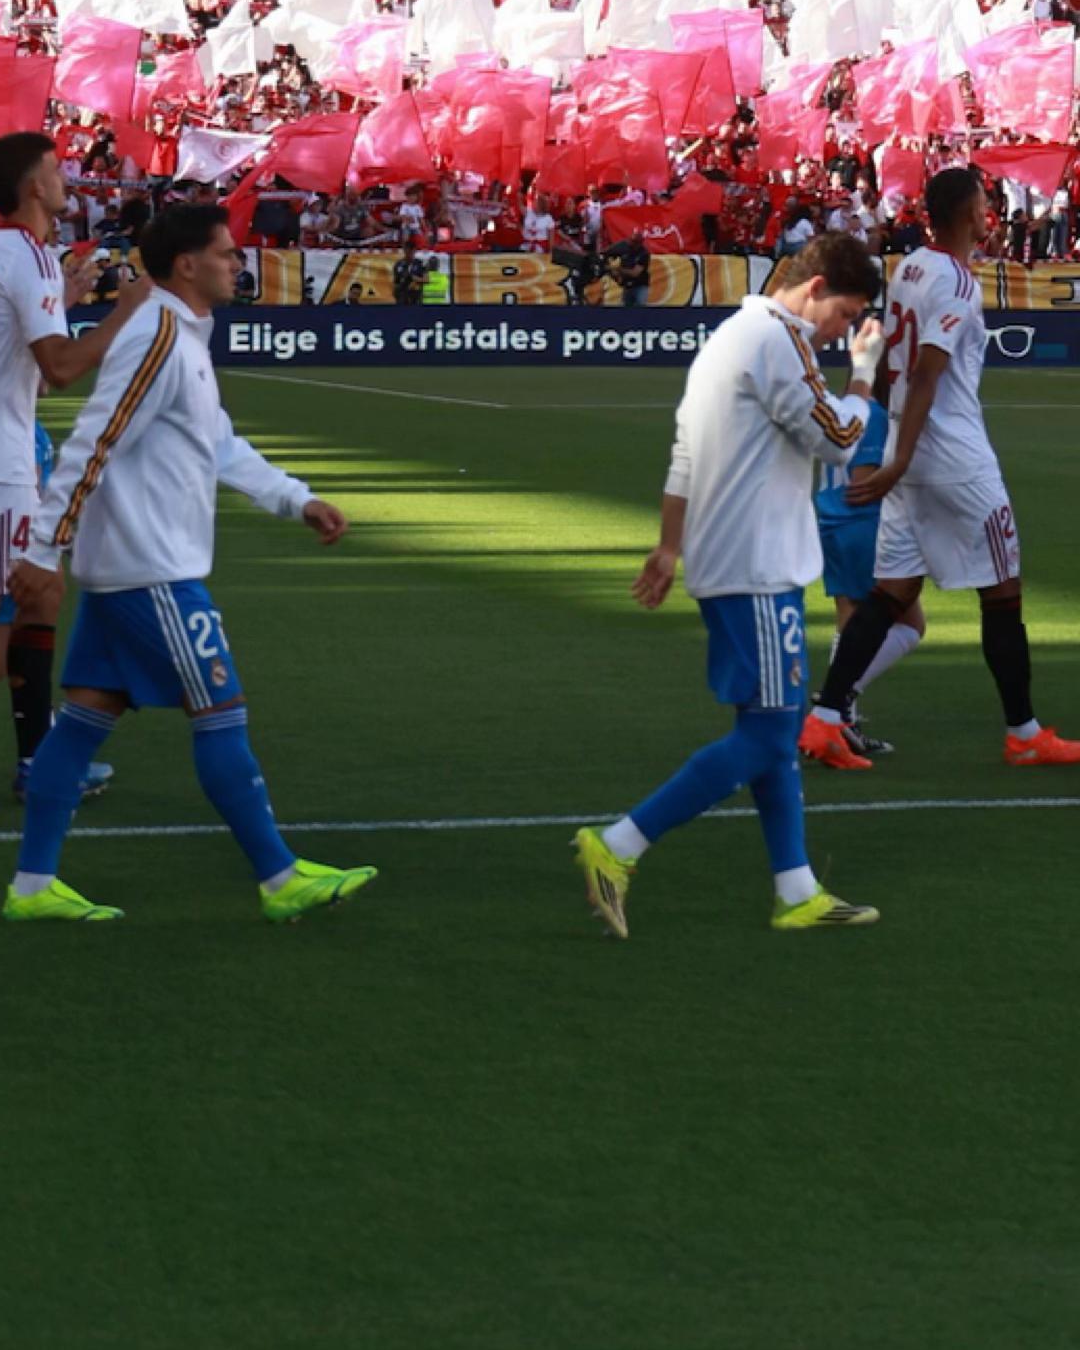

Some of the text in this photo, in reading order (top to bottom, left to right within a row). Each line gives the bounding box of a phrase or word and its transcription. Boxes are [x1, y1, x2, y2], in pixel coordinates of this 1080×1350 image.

[229, 321, 715, 359] Elige los cristales progresi
[12, 514, 30, 552] 4
